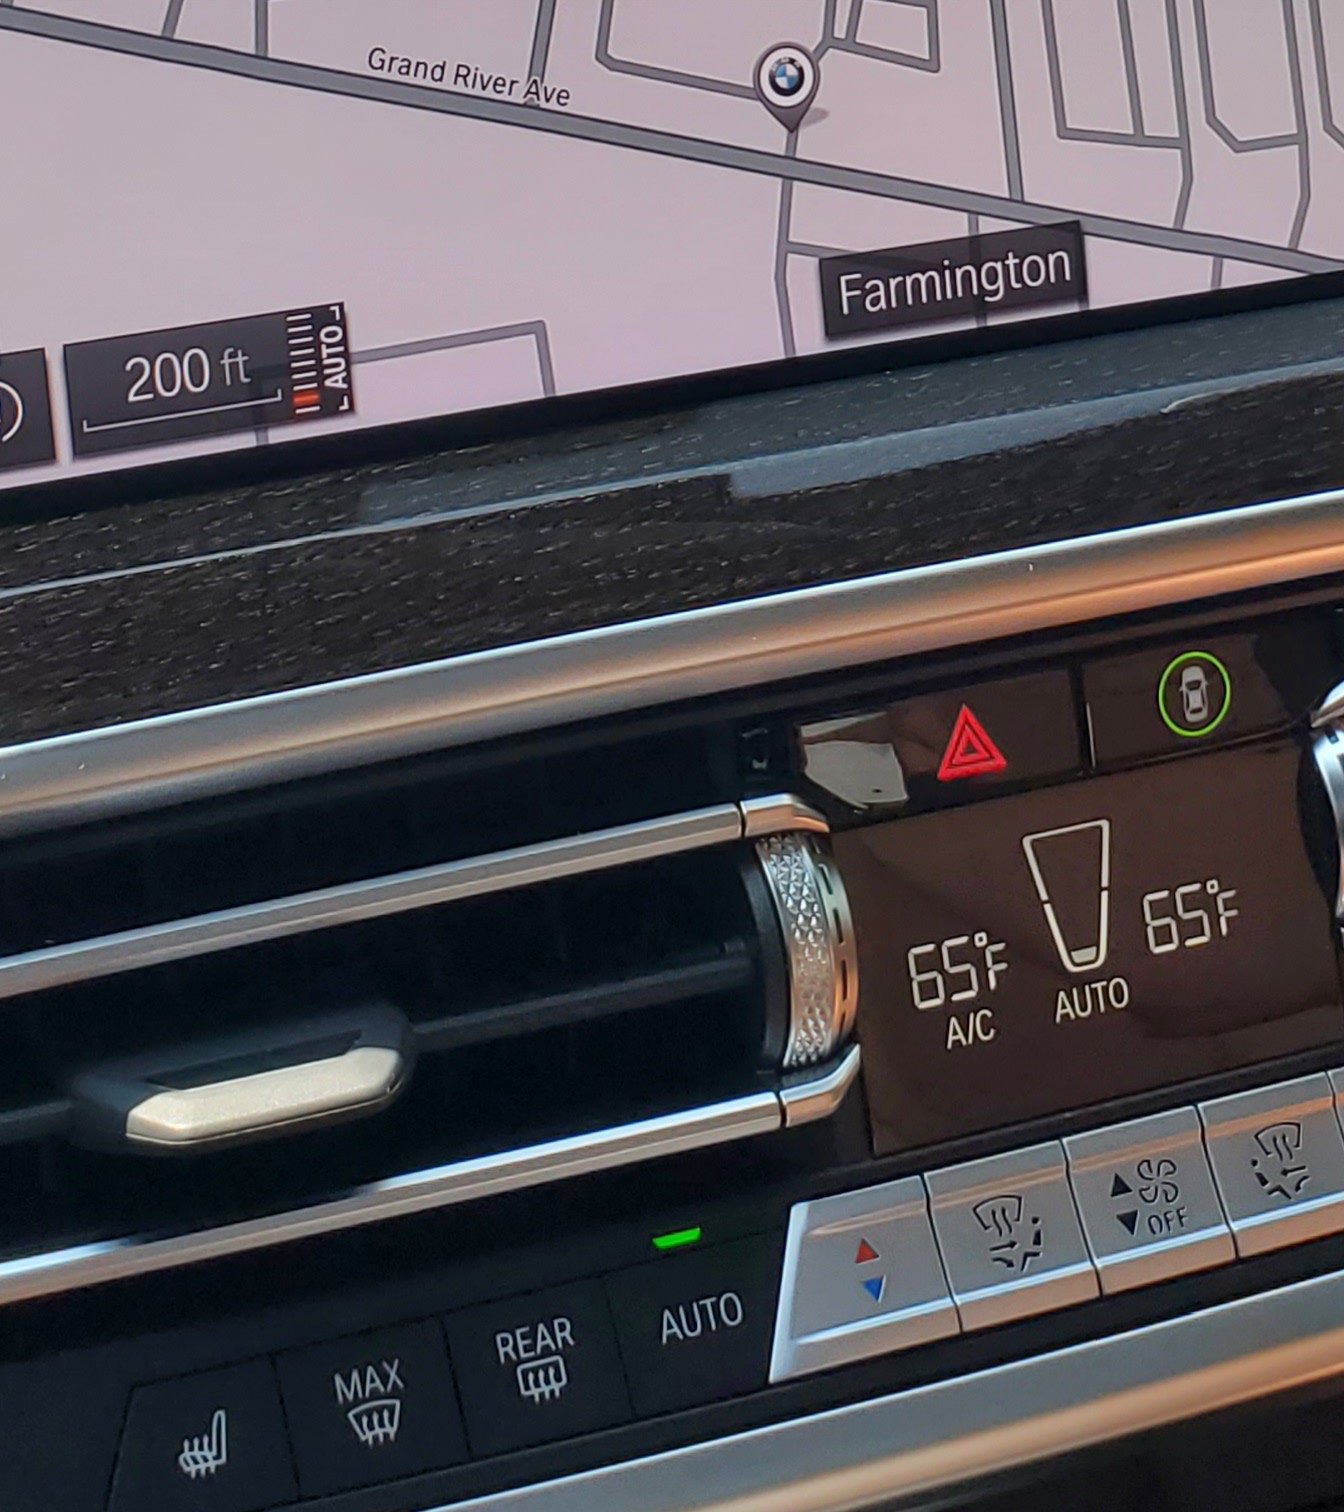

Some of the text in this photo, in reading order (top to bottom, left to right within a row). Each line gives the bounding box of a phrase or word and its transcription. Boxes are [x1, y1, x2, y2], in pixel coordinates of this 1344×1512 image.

[367, 46, 571, 107] Grand River Ave
[838, 248, 1072, 317] Farmington
[124, 346, 252, 404] 200 ft
[319, 323, 349, 391] AUTO
[1053, 976, 1130, 1025] AUTO
[945, 1009, 997, 1052] A/C
[1146, 1206, 1189, 1237] OFF
[495, 1316, 576, 1365] REAR
[660, 1291, 744, 1345] AUTO
[333, 1357, 405, 1406] MAX
